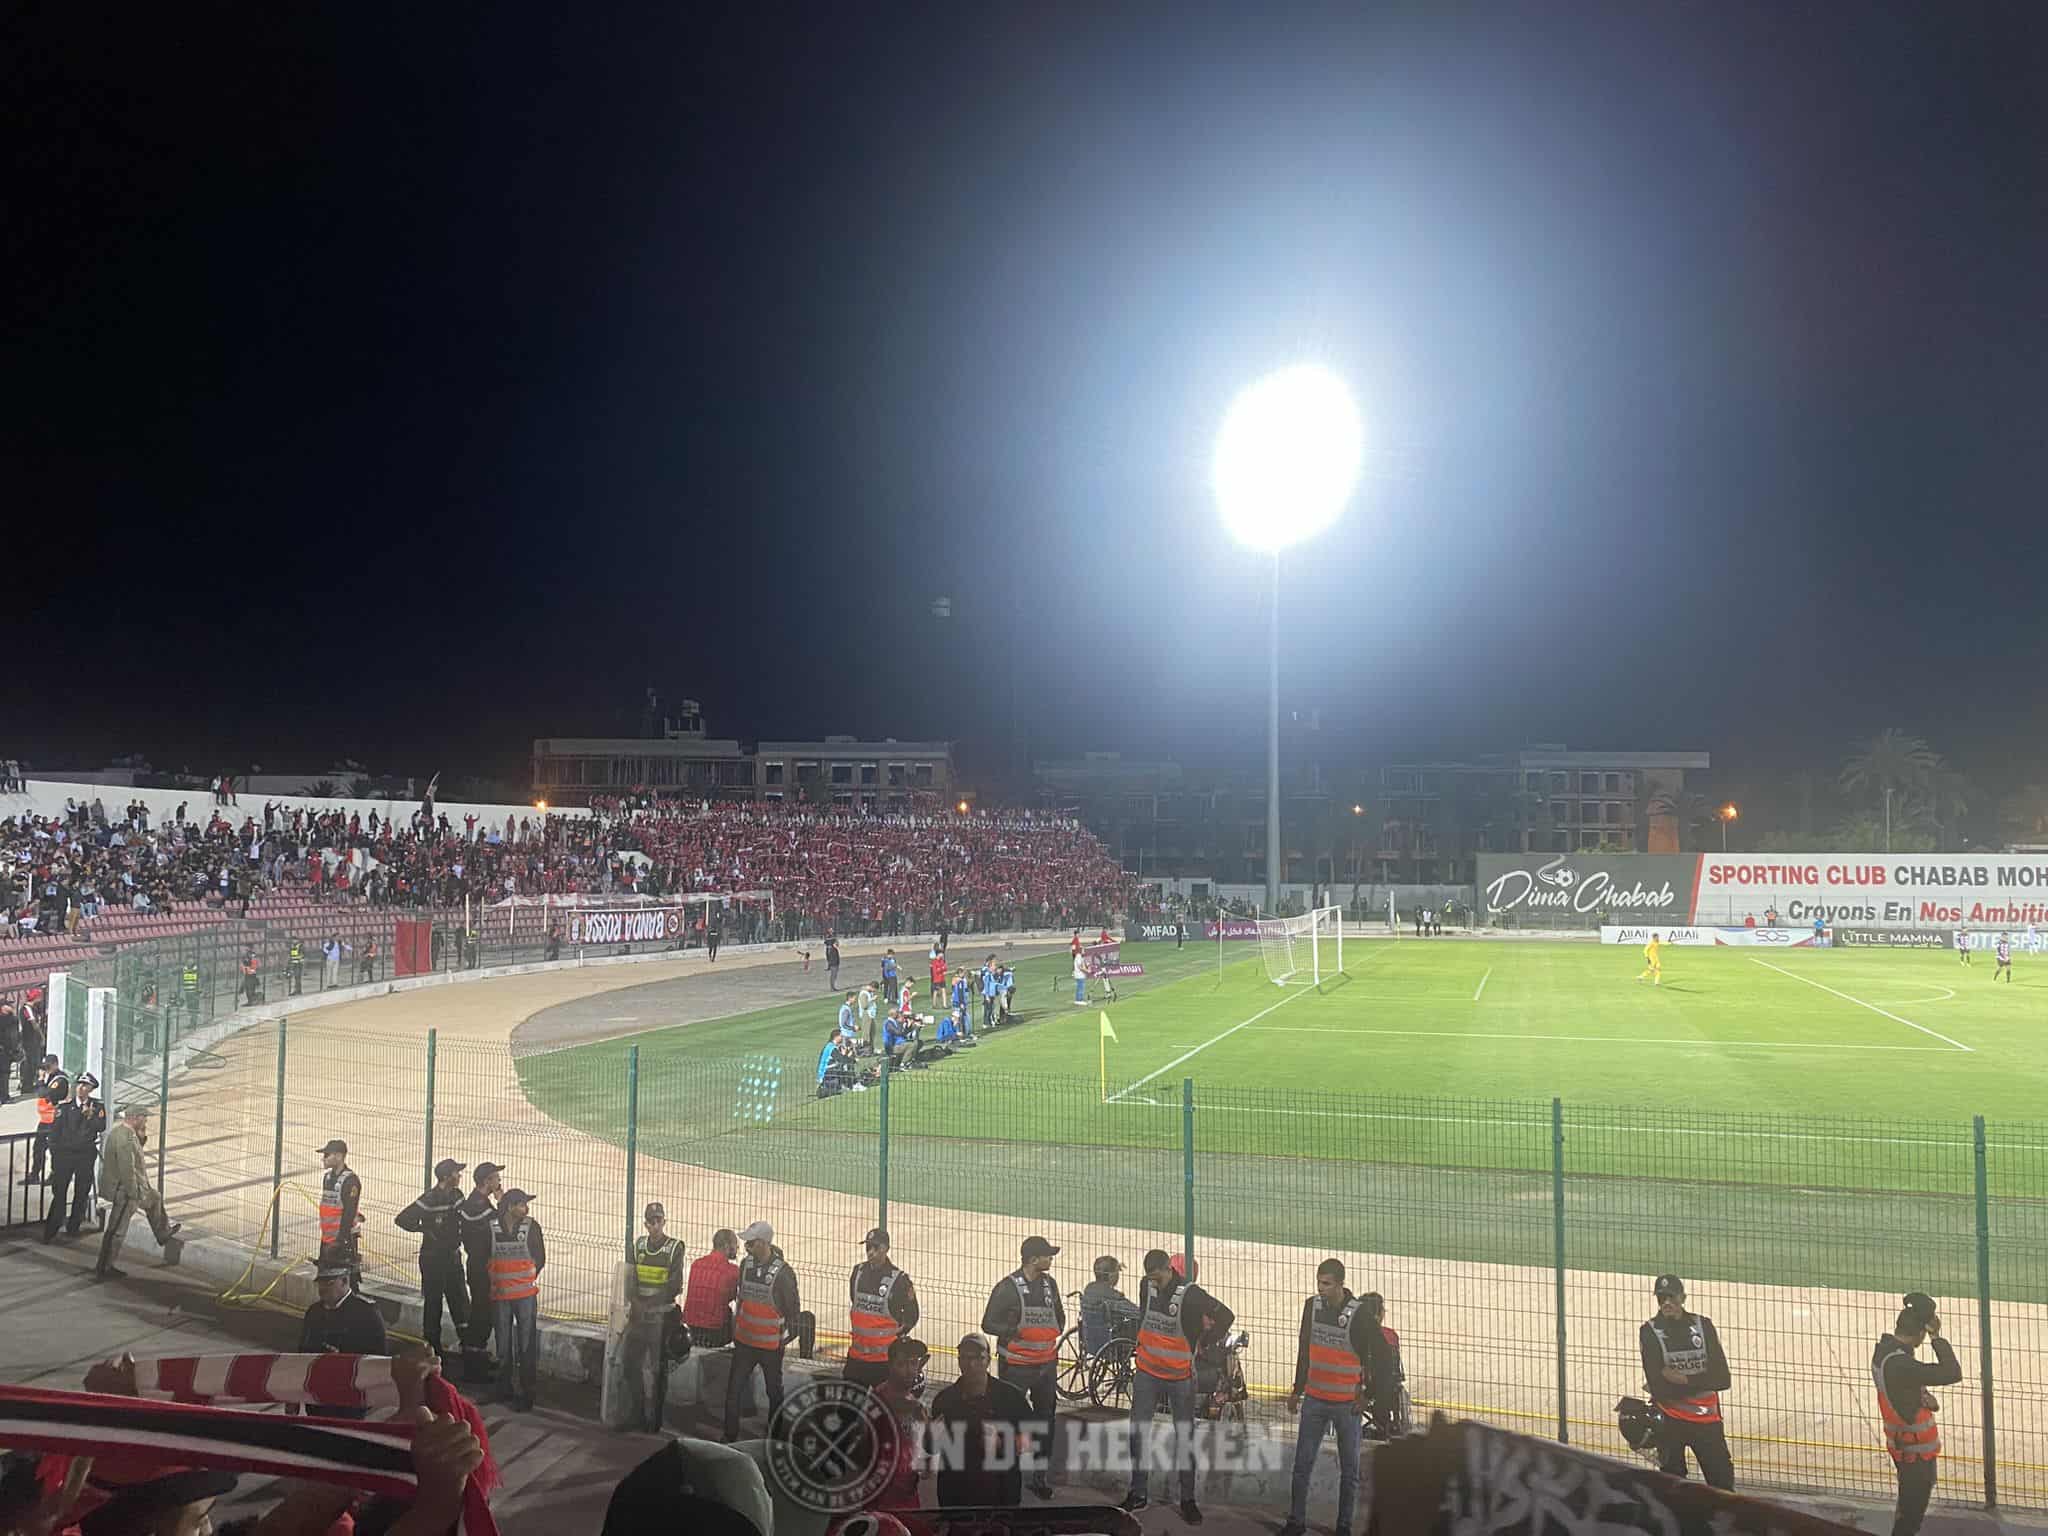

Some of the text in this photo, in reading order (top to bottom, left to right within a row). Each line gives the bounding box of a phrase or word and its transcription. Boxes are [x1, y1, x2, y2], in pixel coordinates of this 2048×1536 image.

[1709, 866, 1819, 885] SPORTING
[1826, 866, 1886, 885] CLUB
[1894, 866, 1989, 886] CHABAB
[1573, 871, 1674, 913] Chabab
[1788, 900, 1876, 923] Croyons
[1883, 901, 1912, 921] En
[1920, 901, 1961, 922] Nos
[584, 911, 664, 943] BANDA ROSSA
[1149, 925, 1189, 937] MFADL
[1841, 929, 1943, 944] LITTLE MAMMA
